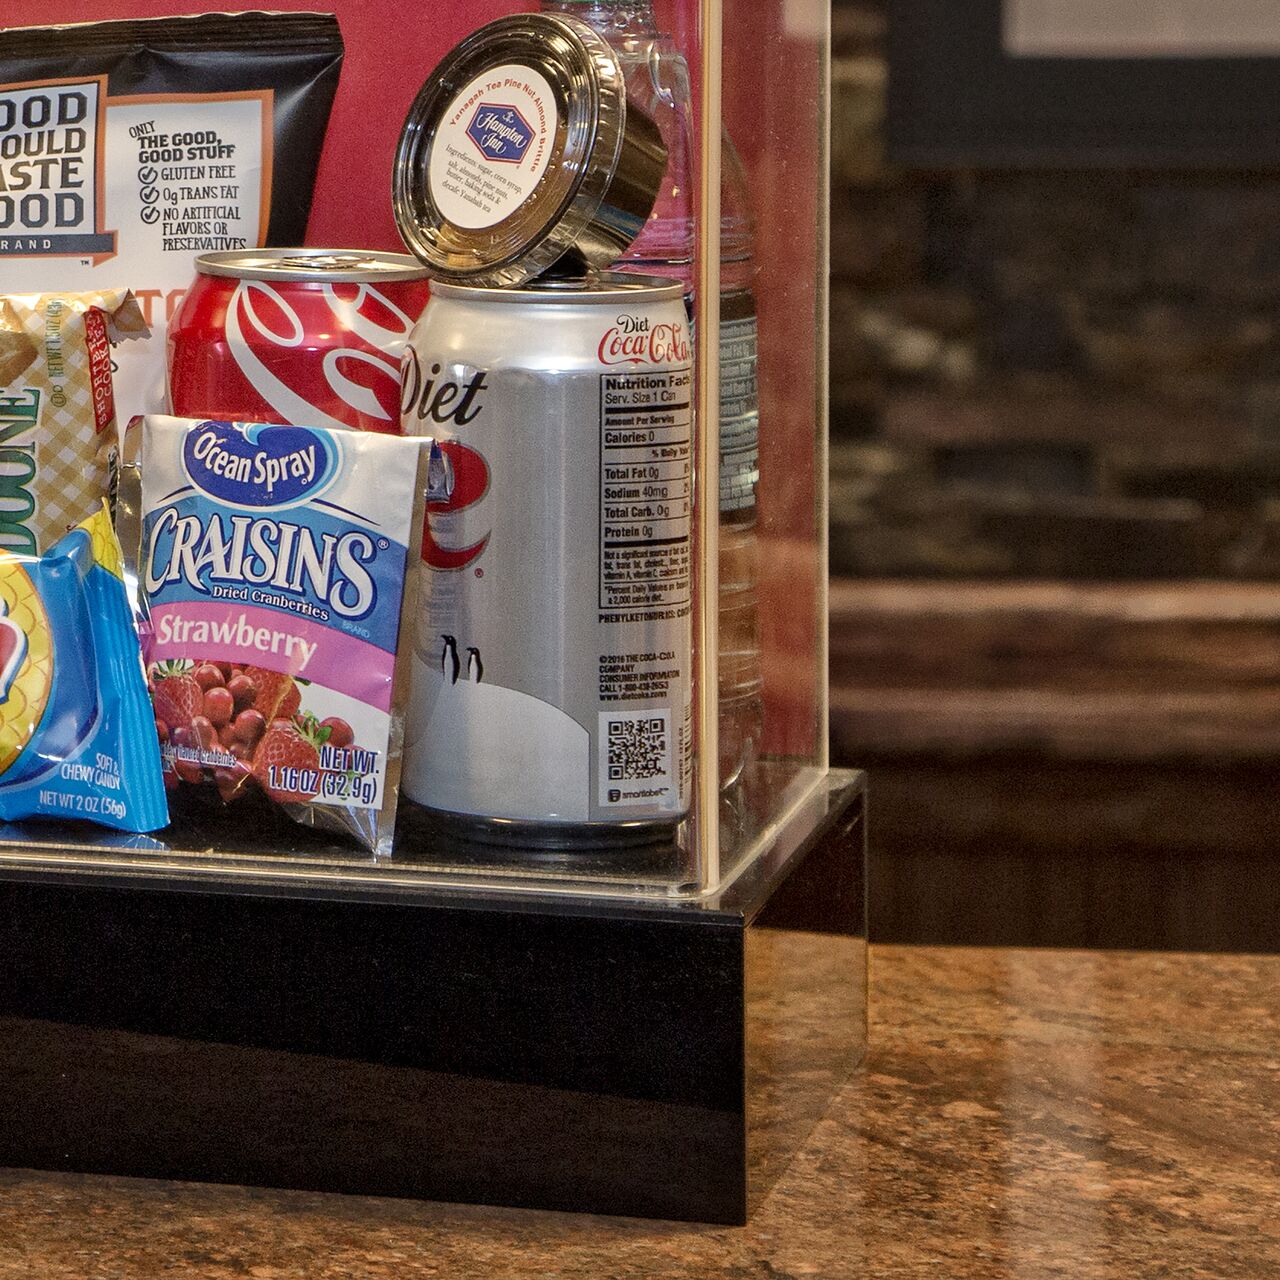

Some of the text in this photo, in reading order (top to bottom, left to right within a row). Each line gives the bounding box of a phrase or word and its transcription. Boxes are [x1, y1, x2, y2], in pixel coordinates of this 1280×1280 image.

[485, 80, 503, 93] Tea
[504, 78, 523, 90] Pine
[522, 83, 537, 99] Nut
[533, 96, 548, 134] Almond
[128, 120, 156, 139] ONLY
[475, 111, 529, 150] Hampton
[137, 131, 223, 149] THE GOOD,
[480, 132, 507, 155] Inn
[138, 144, 237, 164] GOOD STUFF
[160, 165, 237, 181] GLUTEN FREE
[179, 186, 218, 200] TRANS
[220, 185, 240, 200] FAT
[163, 205, 242, 221] NO ARTIFICIAL
[162, 221, 229, 236] FLAVORS OR
[162, 237, 247, 252] PRESERVATIVES
[616, 313, 650, 334] Diet
[605, 376, 667, 391] Nutrition
[605, 393, 630, 404] Serv.
[632, 391, 651, 403] Size
[652, 391, 659, 402] 1
[605, 431, 655, 444] Calories 0
[193, 431, 316, 493] Ocean Spray
[604, 466, 660, 481] Total Fat 0g
[604, 485, 669, 499] Sodium 40mg
[604, 504, 670, 519] Total Carb. 0g
[604, 525, 654, 539] Protein 0g
[144, 506, 376, 620] CRAISINS
[212, 585, 330, 621] Dried Cranberries
[156, 614, 319, 673] Strawberry
[95, 752, 113, 773] SOFT
[319, 746, 380, 774] NET WT.
[60, 763, 121, 791] CHEWY CANDY
[268, 765, 378, 804] 1.16 OZ (32.9g)
[39, 789, 127, 820] NET WT 2 OZ (56g)
